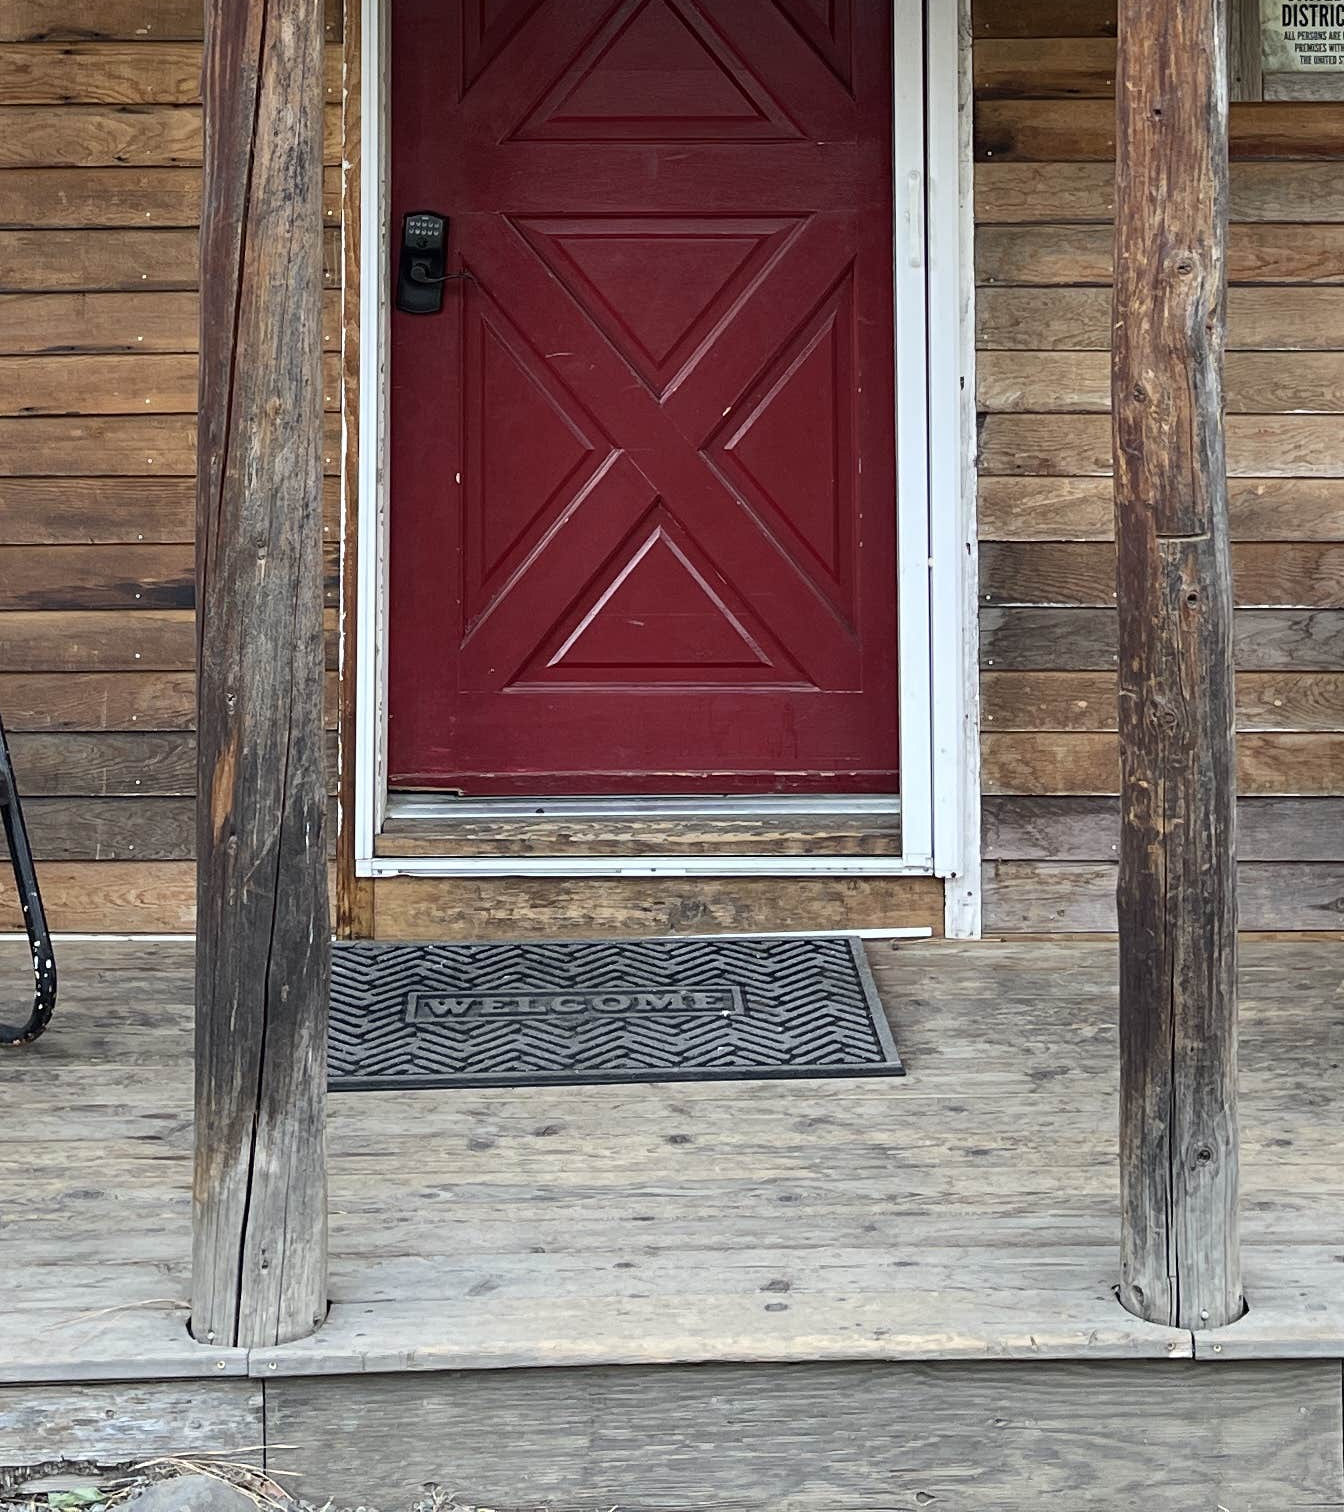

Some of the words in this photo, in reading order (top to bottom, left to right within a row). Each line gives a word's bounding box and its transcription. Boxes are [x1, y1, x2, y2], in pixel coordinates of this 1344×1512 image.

[1283, 30, 1295, 41] ALL
[1297, 30, 1327, 41] PERSONS
[1328, 30, 1341, 41] ARE
[1313, 54, 1337, 65] UNITED
[424, 992, 725, 1016] WELCOME
